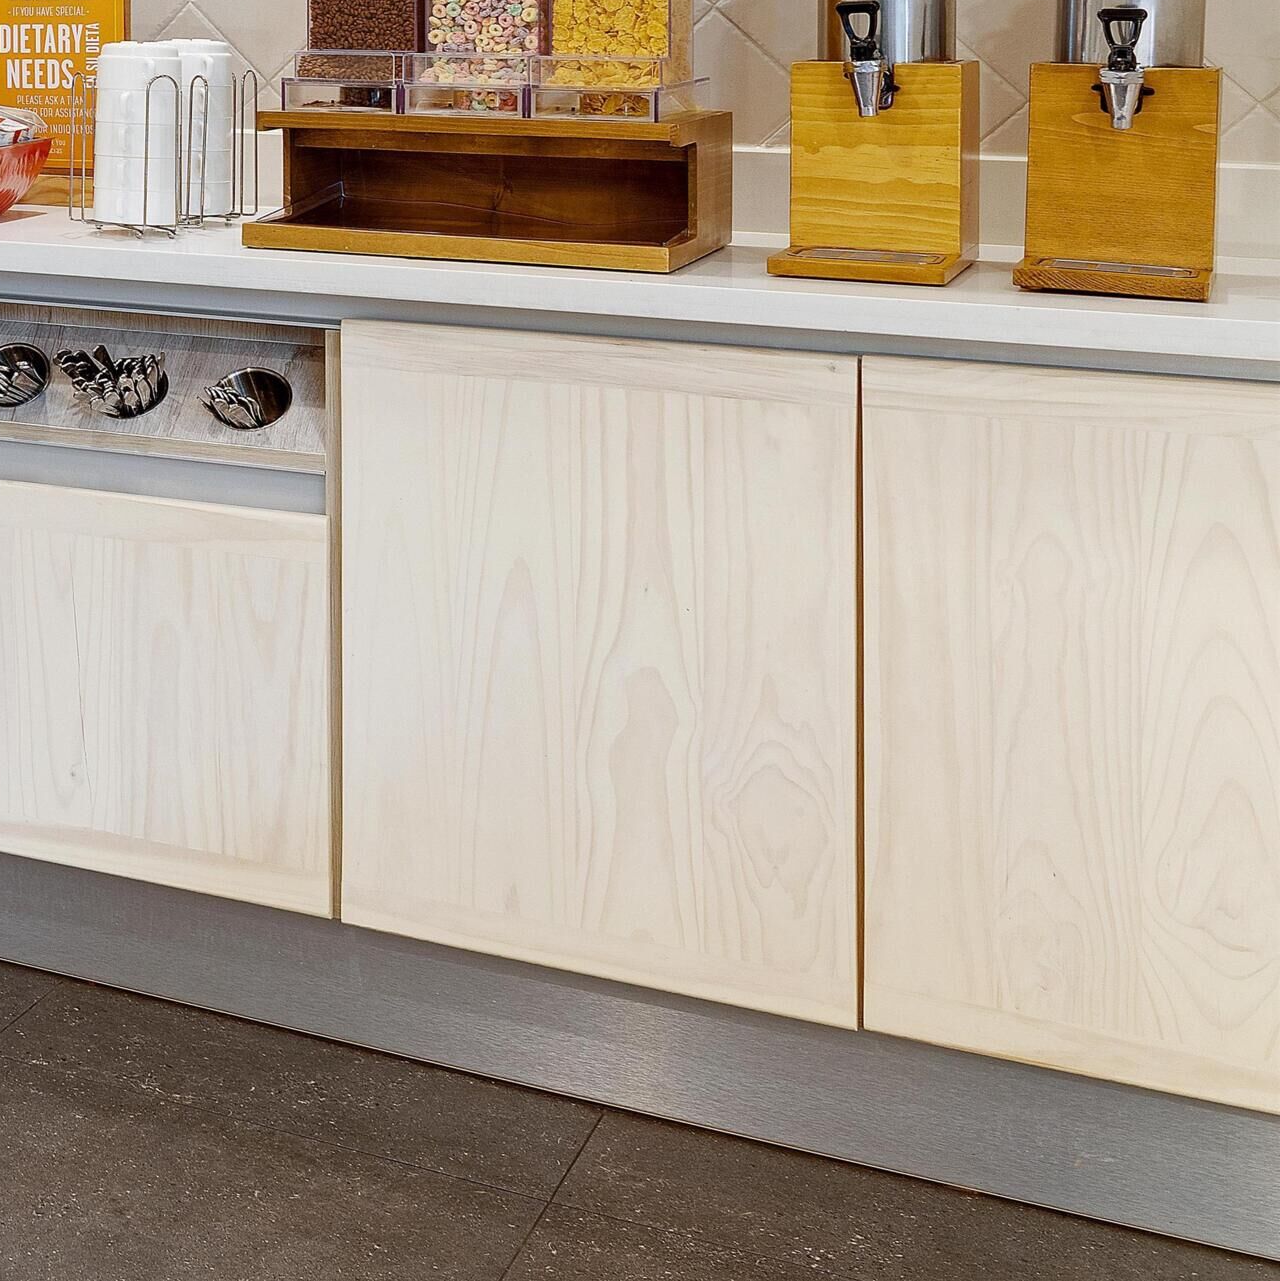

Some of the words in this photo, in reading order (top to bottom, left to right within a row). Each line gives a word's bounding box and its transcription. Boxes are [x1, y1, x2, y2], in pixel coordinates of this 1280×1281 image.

[12, 6, 19, 16] IF
[20, 6, 34, 16] YOU
[36, 6, 53, 16] HAVE
[55, 5, 85, 16] SPECIAL
[0, 23, 83, 54] DIETARY
[85, 23, 100, 53] DIETA
[85, 57, 98, 71] SU
[6, 58, 74, 89] NEEDS
[16, 95, 42, 105] PLEASE
[44, 95, 58, 105] ASK
[60, 96, 65, 105] A
[40, 107, 53, 118] FOR
[50, 124, 94, 135] INDIQEOS
